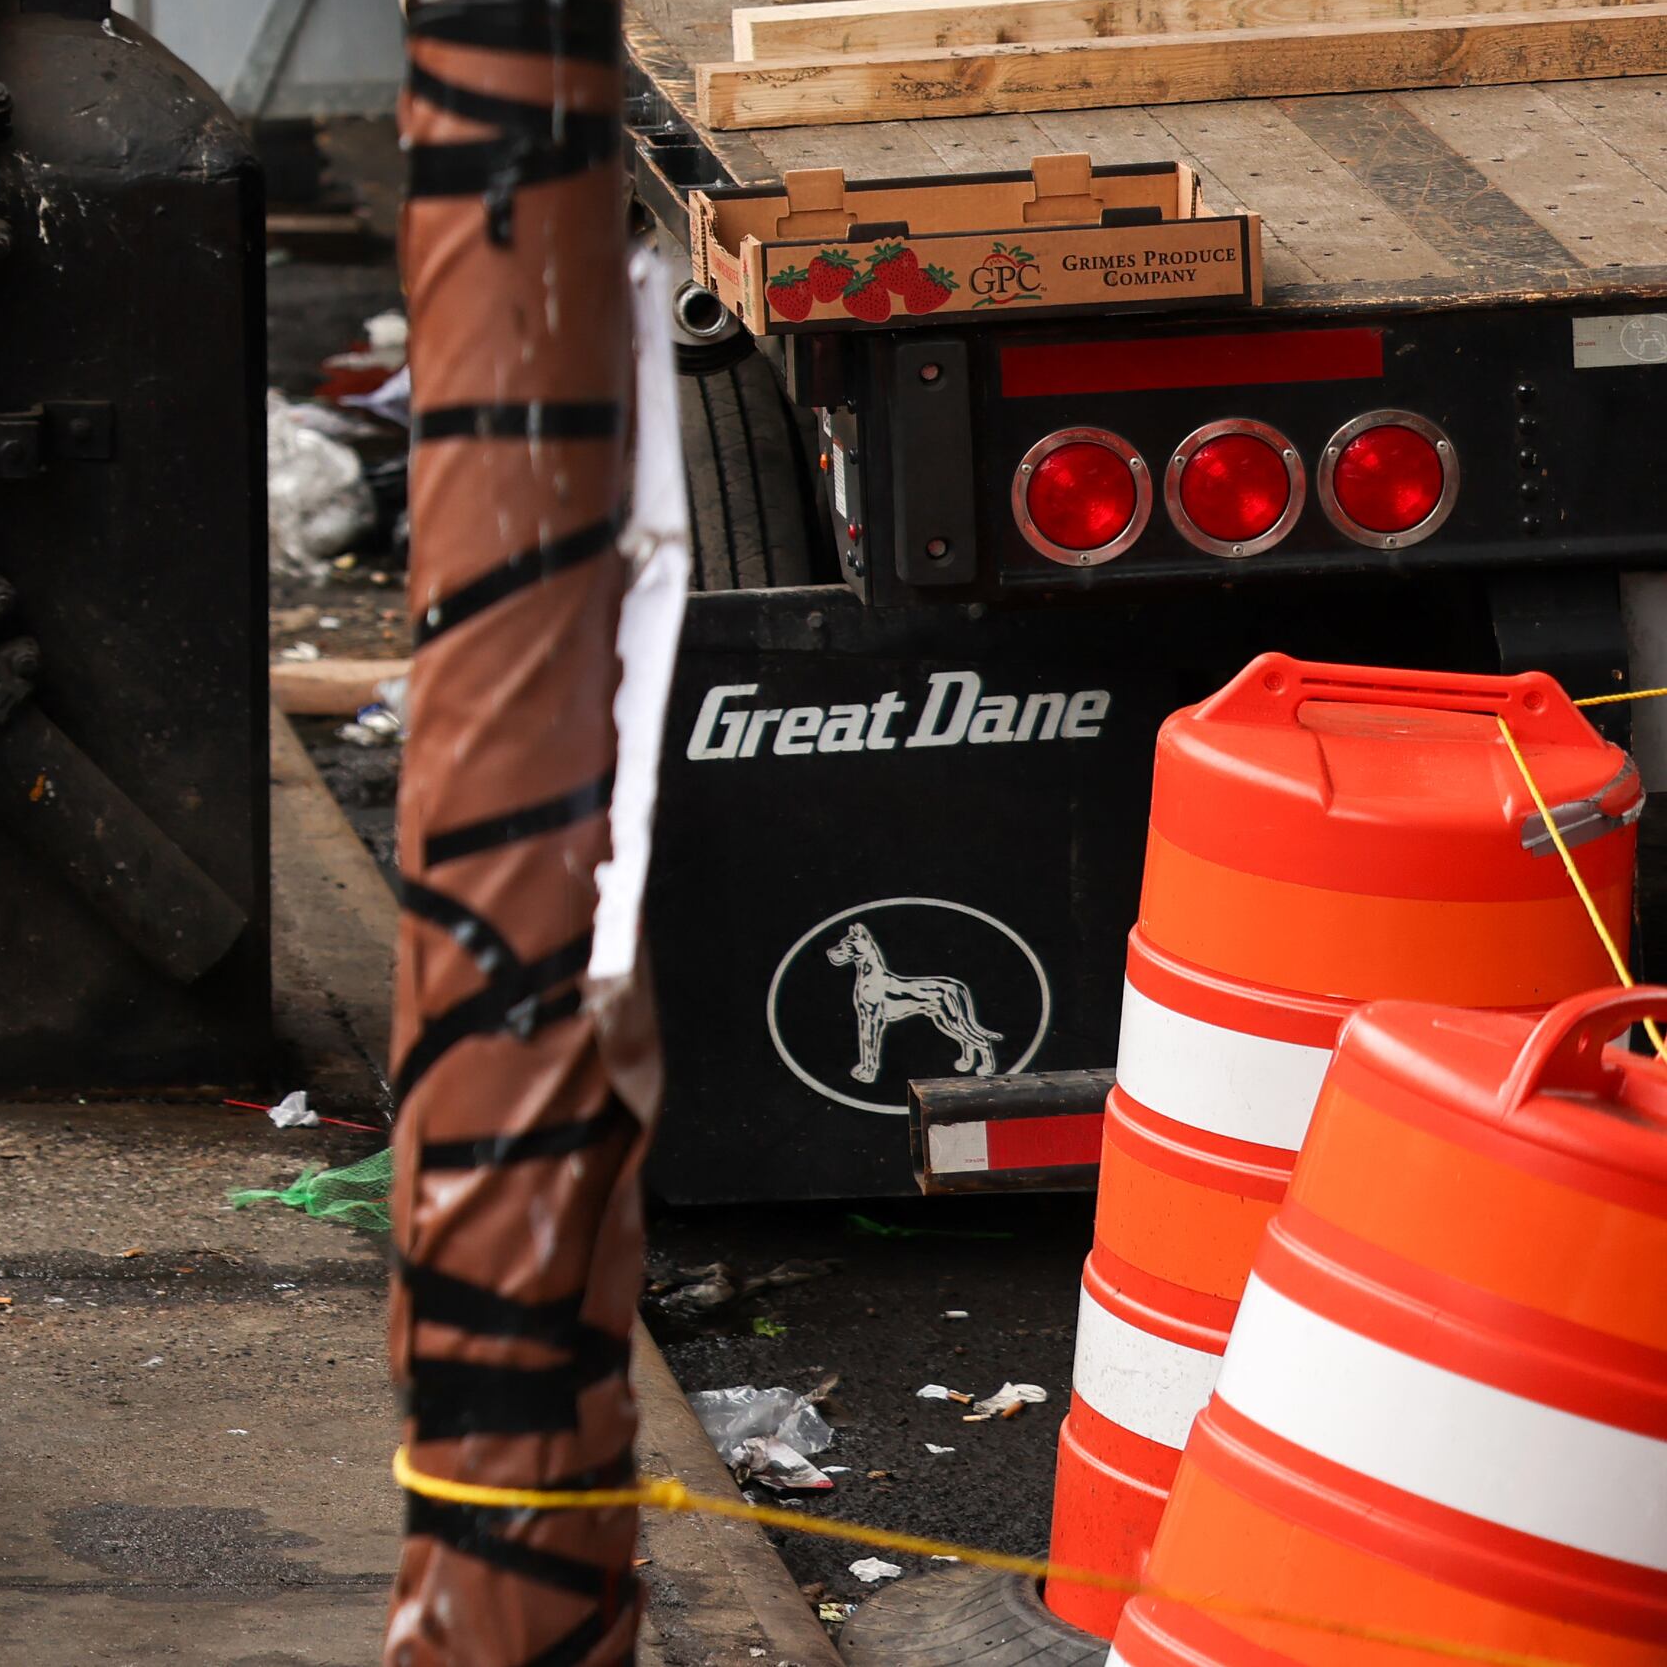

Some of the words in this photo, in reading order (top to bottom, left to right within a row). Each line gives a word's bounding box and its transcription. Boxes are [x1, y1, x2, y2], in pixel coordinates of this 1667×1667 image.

[1061, 254, 1136, 271] GRIMES
[1143, 247, 1237, 267] PRODUCE
[968, 263, 1042, 296] GPC
[1102, 268, 1197, 287] COMPANY
[686, 683, 906, 761] Great
[905, 670, 1112, 749] Dane
